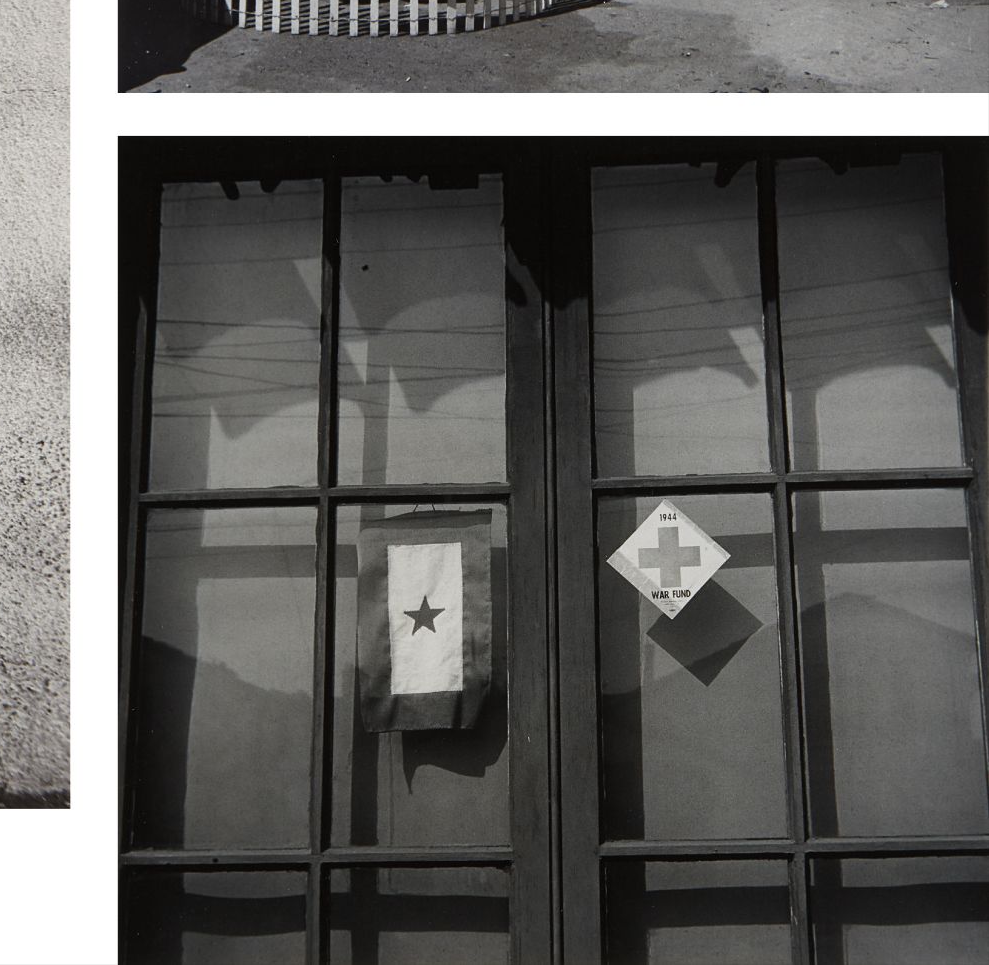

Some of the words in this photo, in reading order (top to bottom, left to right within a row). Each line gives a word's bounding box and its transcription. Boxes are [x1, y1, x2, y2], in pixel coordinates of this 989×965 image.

[659, 513, 677, 521] 1944
[651, 590, 669, 599] WAR
[672, 589, 691, 598] FUND
